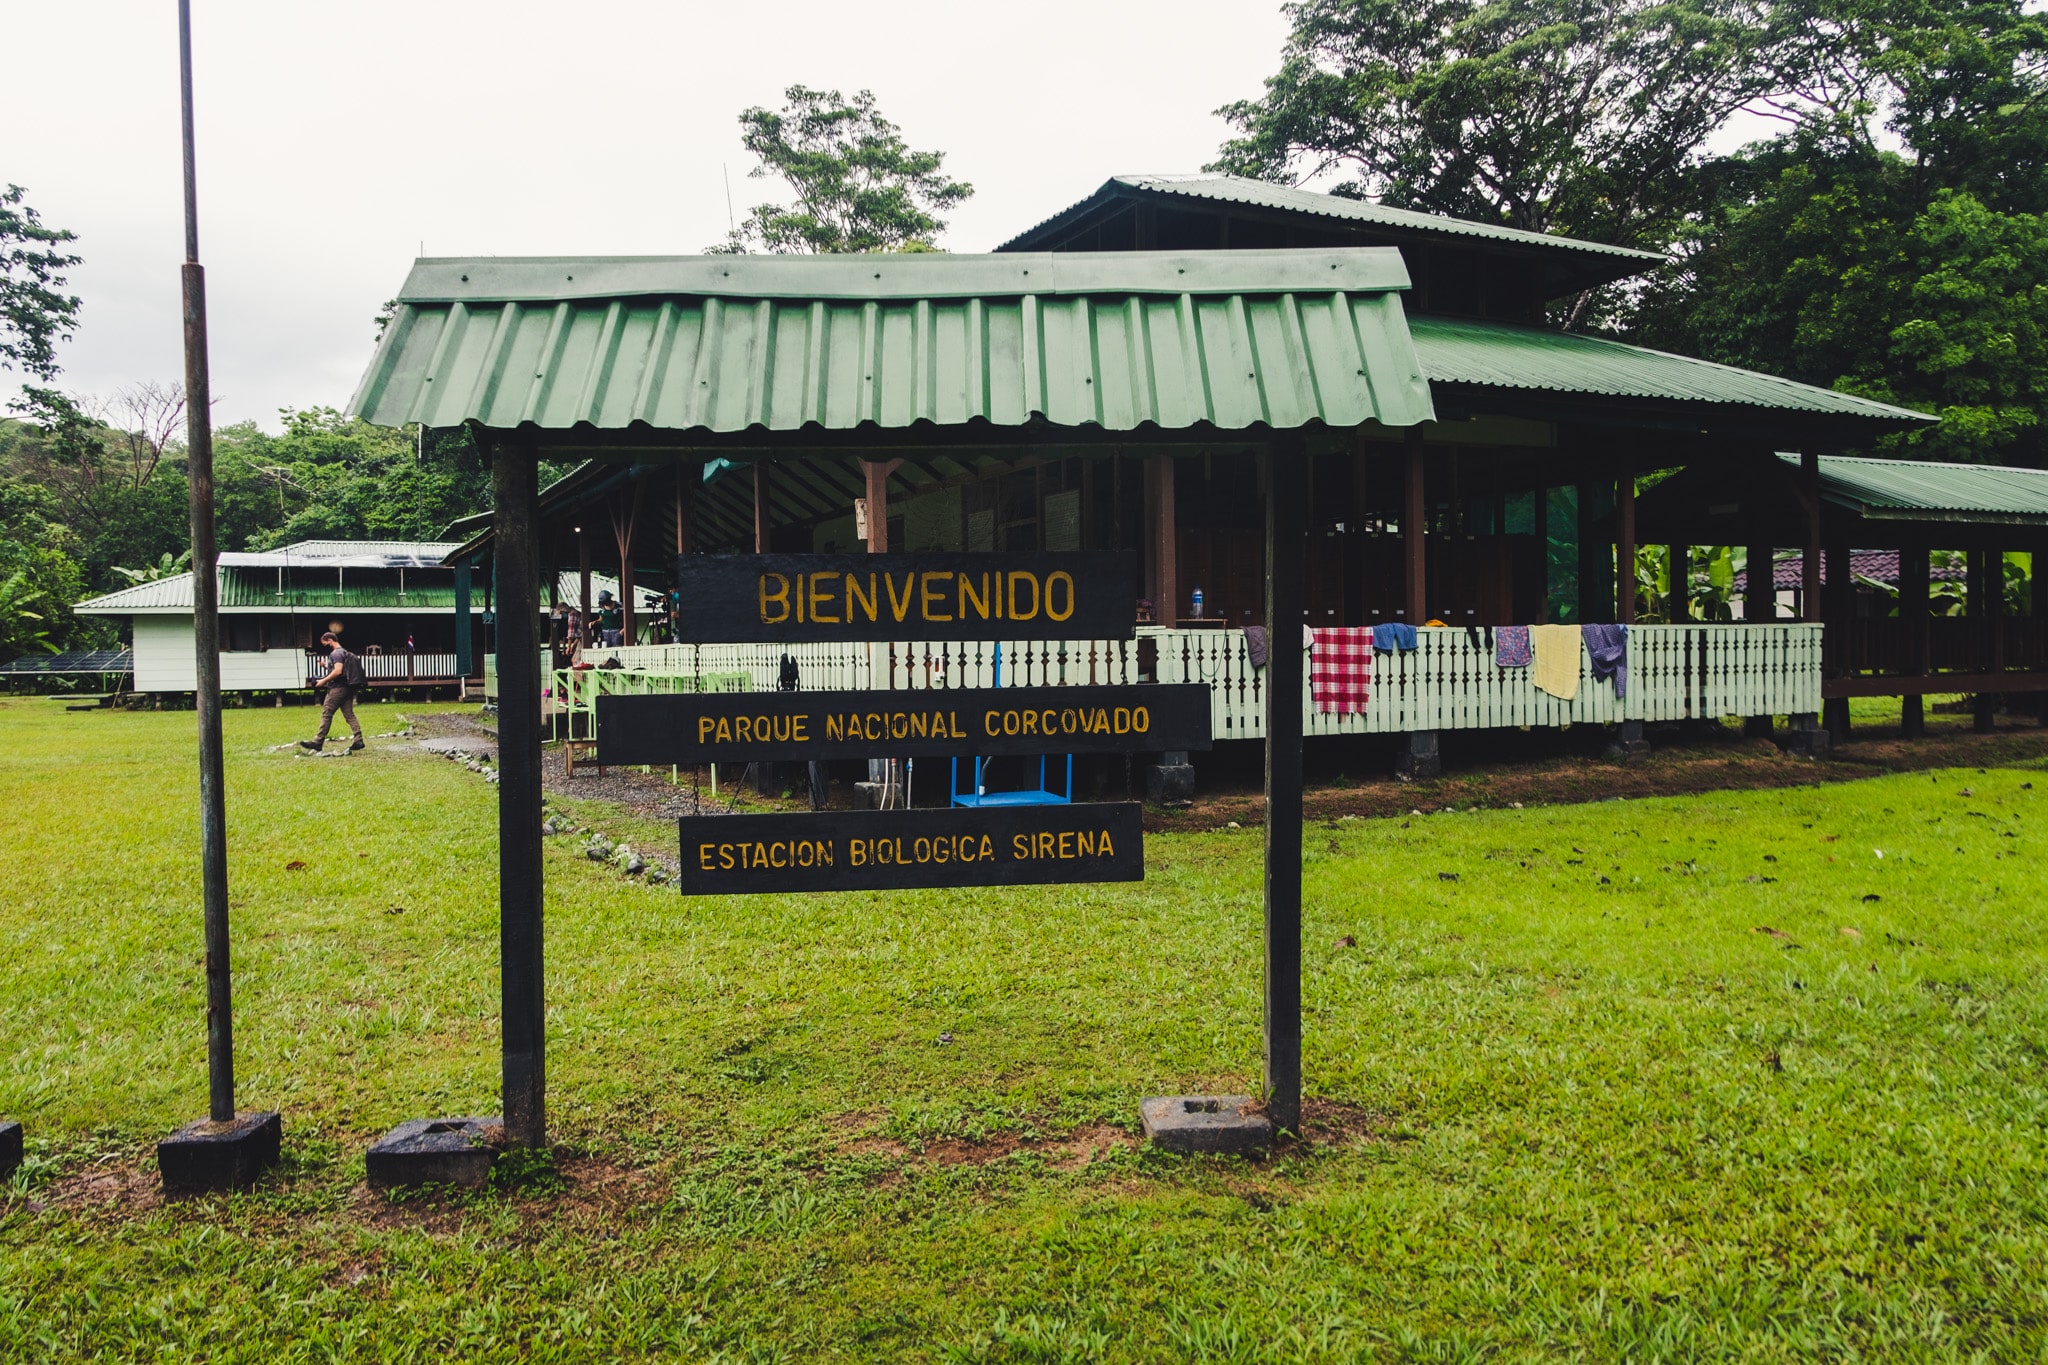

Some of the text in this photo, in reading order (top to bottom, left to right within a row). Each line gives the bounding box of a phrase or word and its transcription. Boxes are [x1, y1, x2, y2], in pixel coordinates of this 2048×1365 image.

[759, 571, 1076, 624] BIENVENIDO
[698, 706, 1150, 744] PARQUE NACIONAL CORCOVADO
[699, 830, 1115, 871] ESTACION BIOLOGICA SIRENA
